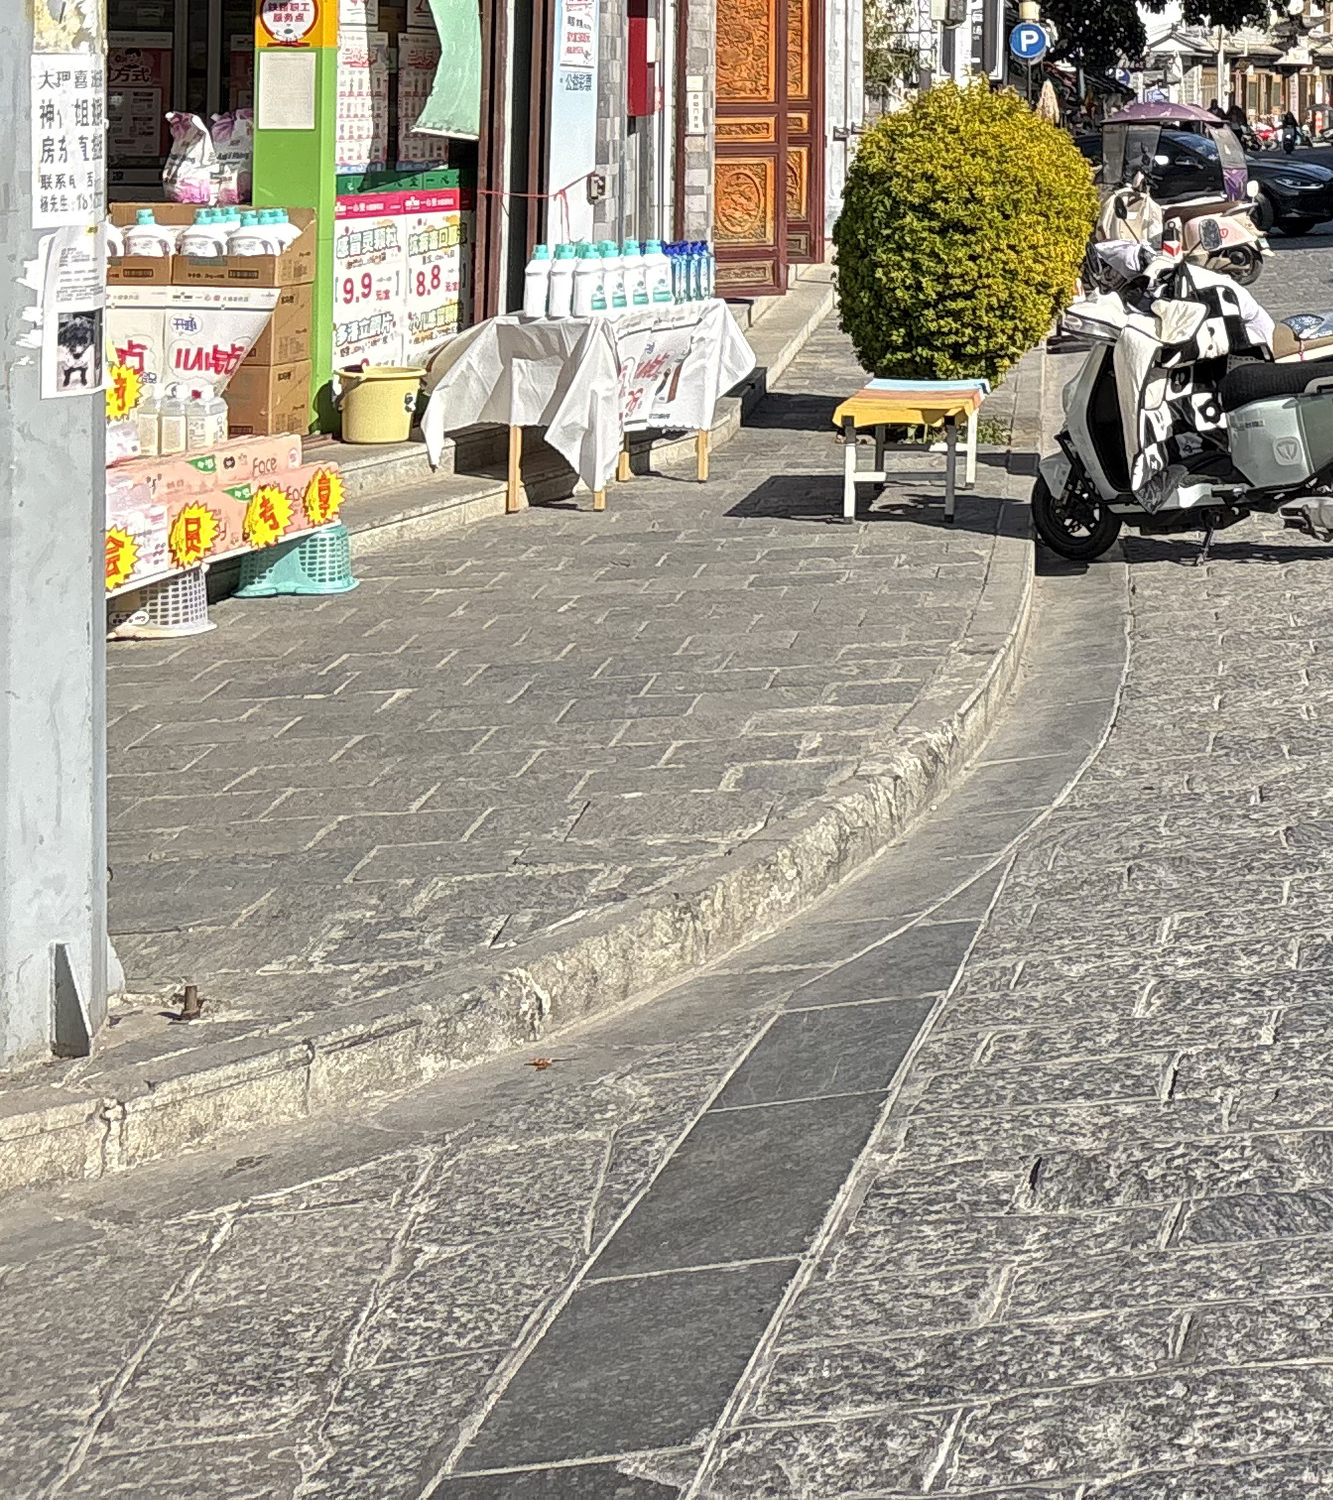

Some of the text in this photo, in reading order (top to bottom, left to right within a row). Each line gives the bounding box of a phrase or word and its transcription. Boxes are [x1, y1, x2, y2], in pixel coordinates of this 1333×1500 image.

[267, 2, 311, 12] 铁路职工
[272, 13, 305, 23] 服务点
[1020, 31, 1040, 52] P
[342, 272, 373, 304] 9.9
[416, 264, 441, 297] 8.8
[252, 457, 277, 477] Face
